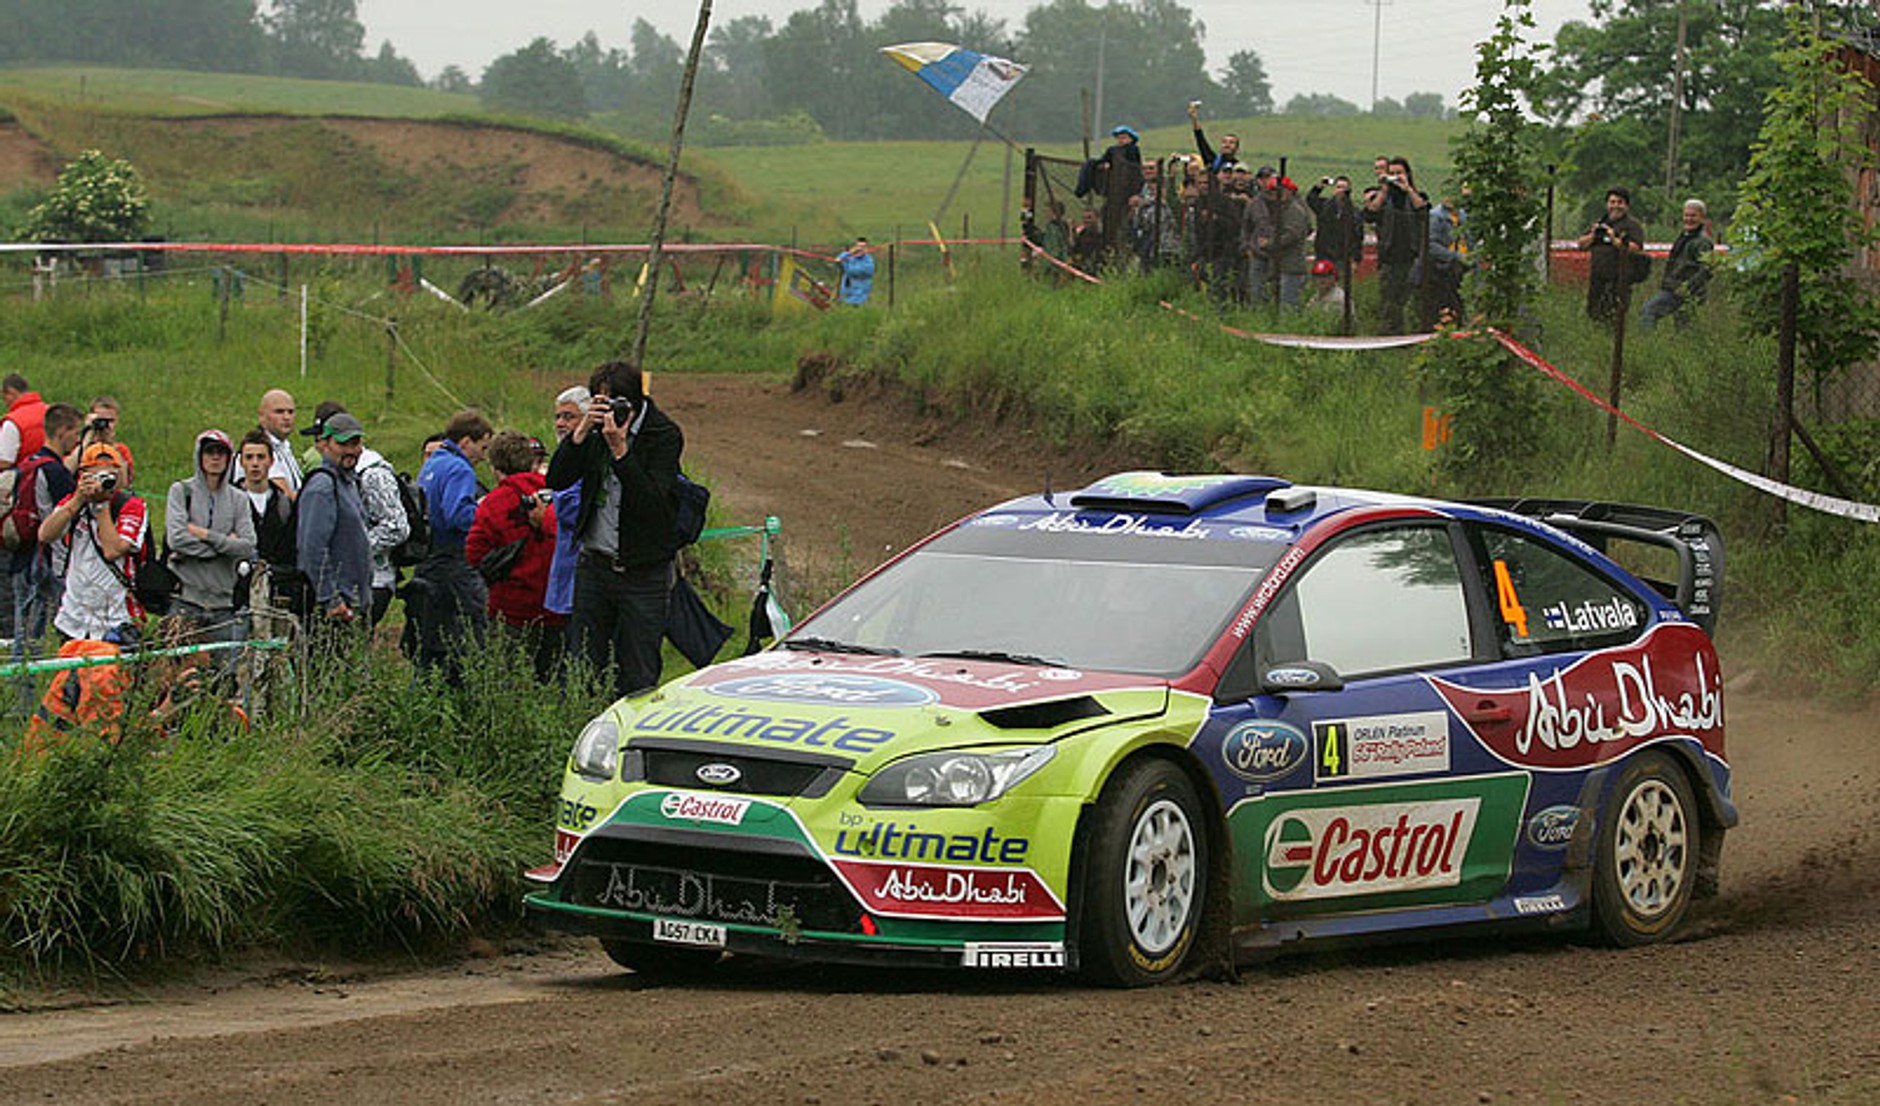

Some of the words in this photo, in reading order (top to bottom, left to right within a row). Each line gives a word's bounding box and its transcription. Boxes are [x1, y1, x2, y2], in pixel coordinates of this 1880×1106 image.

[1018, 511, 1102, 533] Abu
[1098, 514, 1211, 539] Dhabi
[1494, 560, 1530, 637] 4
[1560, 596, 1638, 631] Latvala
[1516, 671, 1626, 755] Abu
[1612, 651, 1724, 737] Dhabi
[634, 704, 895, 753] ultimate
[1238, 729, 1291, 769] Ford
[1323, 725, 1339, 775] 4
[680, 796, 743, 822] Castrol
[840, 811, 863, 827] bp
[834, 822, 1029, 863] ultimate
[1313, 810, 1464, 886] Castrol
[597, 863, 672, 913] Abu
[874, 868, 942, 902] Abu
[940, 871, 1027, 904] Dhabi
[962, 941, 1064, 967] PIRELLI
